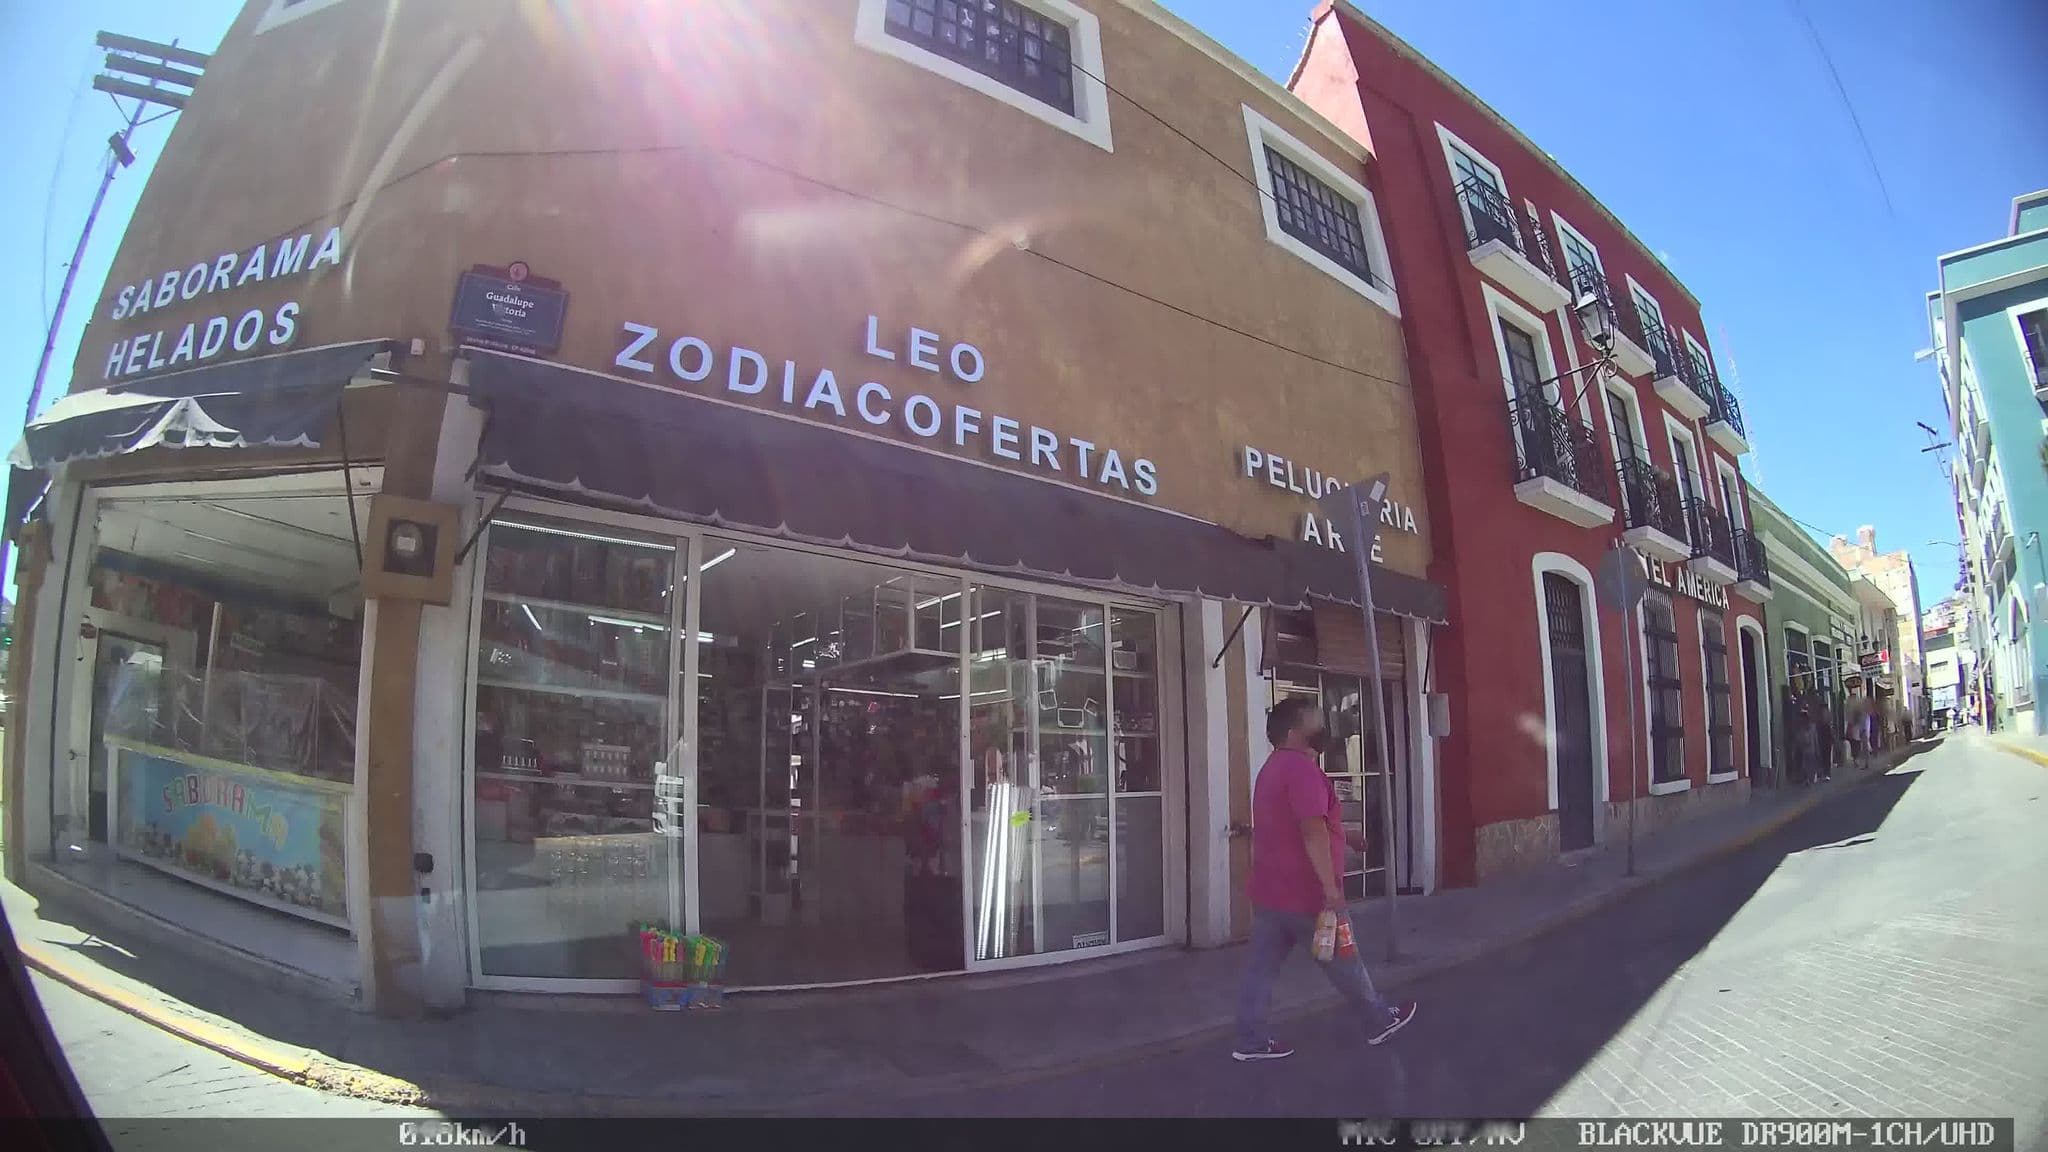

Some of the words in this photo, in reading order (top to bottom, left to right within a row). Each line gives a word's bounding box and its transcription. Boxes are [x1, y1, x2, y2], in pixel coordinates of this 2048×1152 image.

[112, 227, 341, 320] SABORAMA
[486, 292, 534, 309] Guadalupe
[104, 302, 300, 379] HELADOS
[866, 315, 985, 382] LEO
[616, 321, 1158, 496] ZODIACOFERTAS
[1245, 445, 1418, 535] PELURIA
[1303, 512, 1384, 563] ARE
